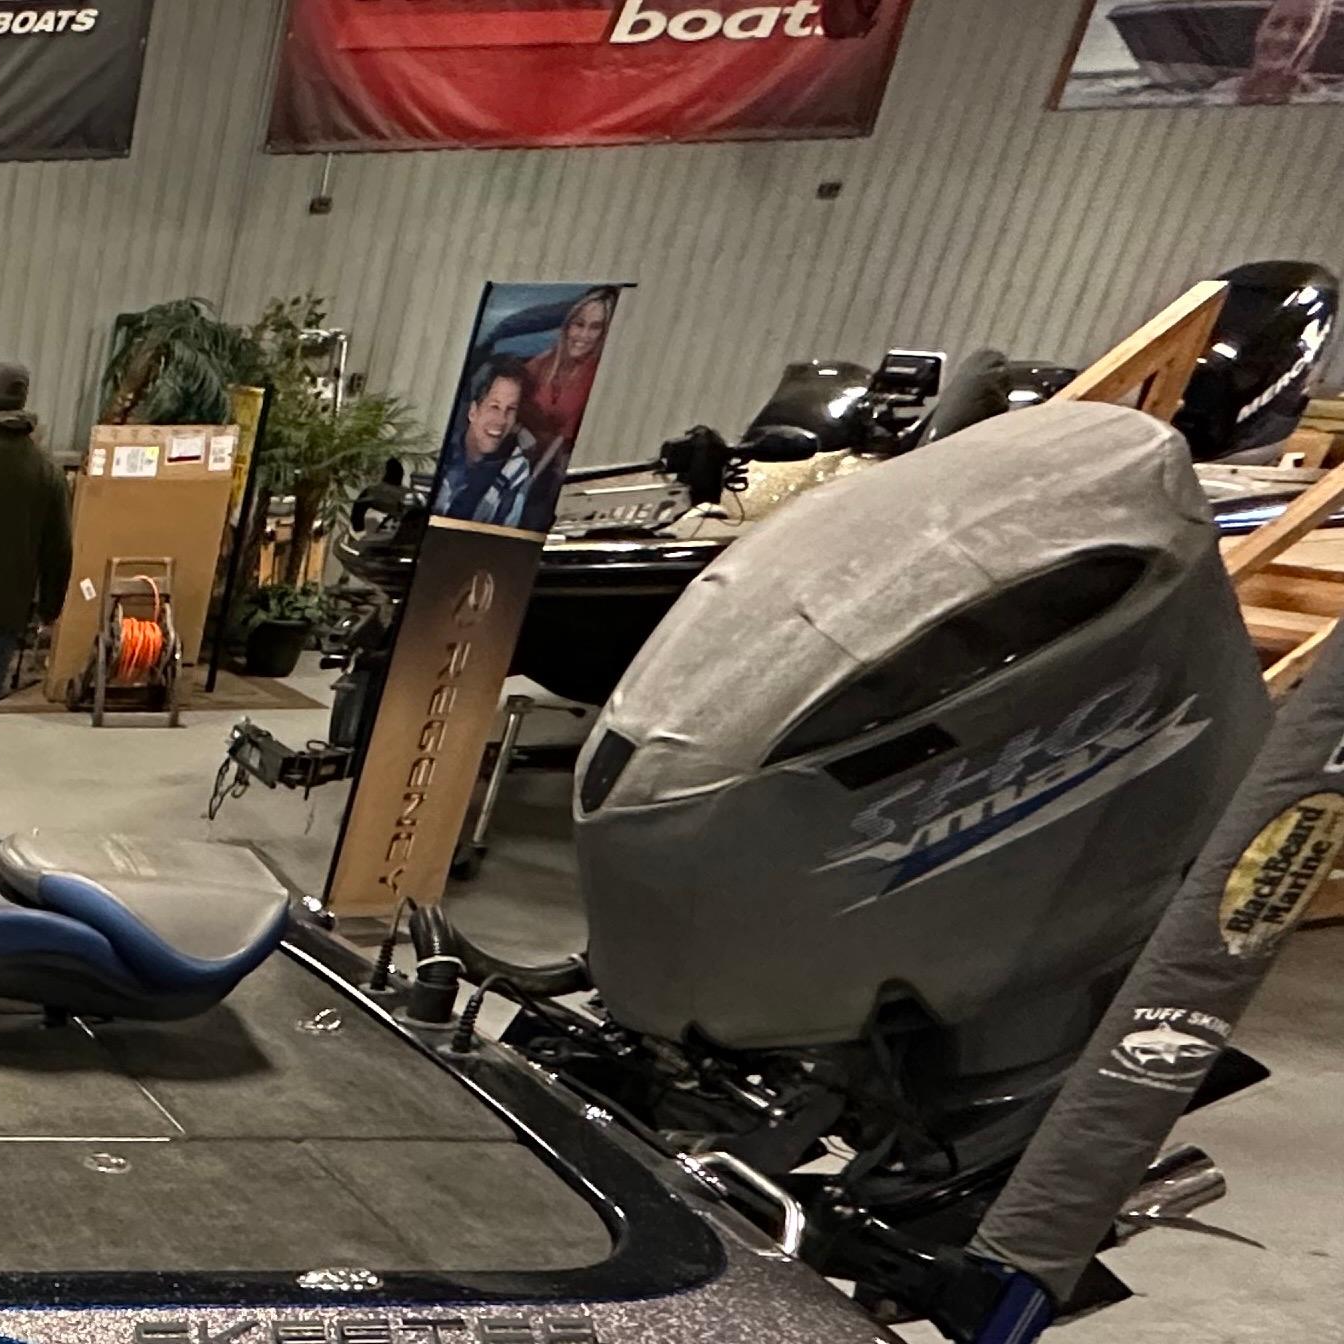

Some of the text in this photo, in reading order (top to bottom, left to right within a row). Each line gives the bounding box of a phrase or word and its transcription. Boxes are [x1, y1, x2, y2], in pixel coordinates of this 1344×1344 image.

[610, 0, 825, 44] boat
[378, 640, 472, 897] REGENCY
[1225, 805, 1326, 934] BlackBeard
[1261, 839, 1334, 926] Marine
[1132, 1007, 1188, 1021] TUFF
